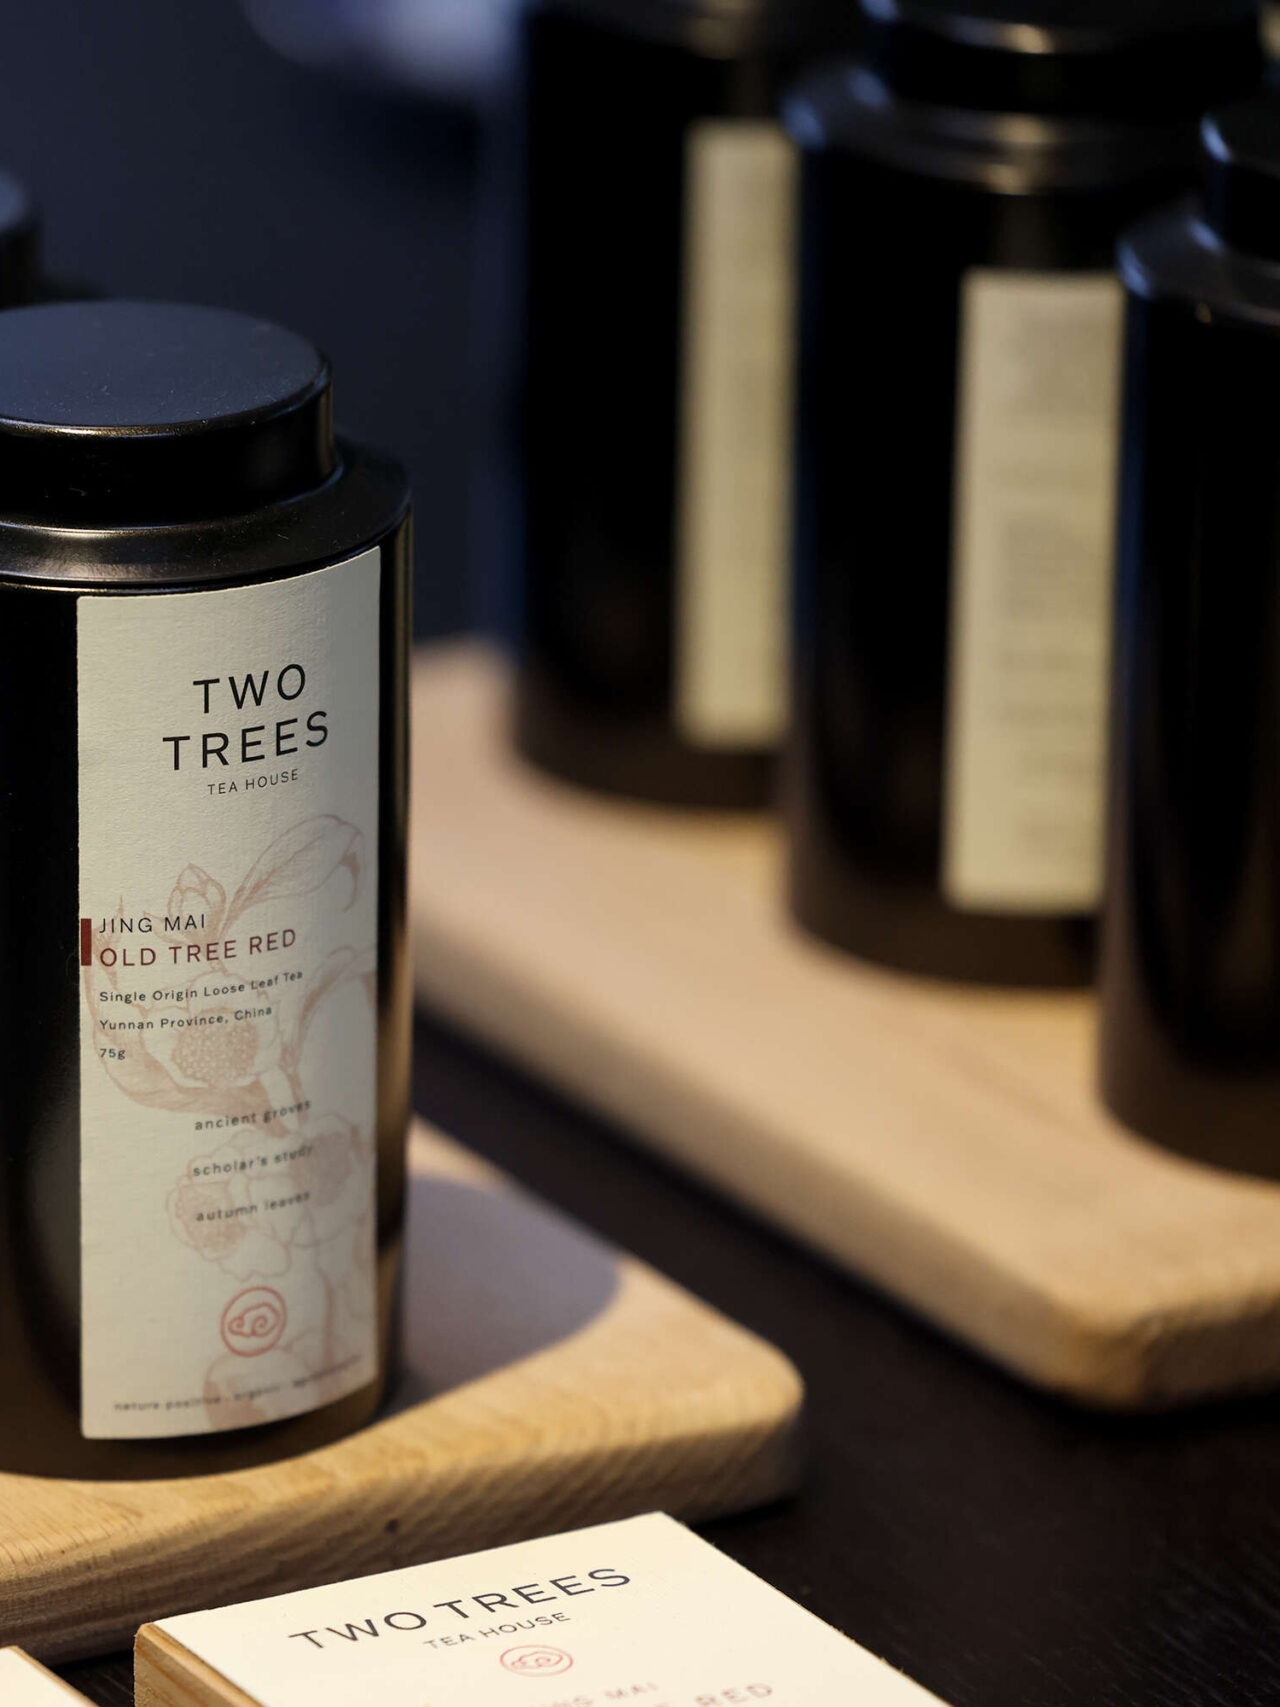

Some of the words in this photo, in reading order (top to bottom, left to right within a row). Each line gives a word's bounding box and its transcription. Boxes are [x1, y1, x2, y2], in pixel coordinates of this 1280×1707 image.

[193, 663, 307, 714] TWO
[162, 710, 329, 770] TREES
[207, 781, 238, 796] TEA
[245, 768, 299, 790] HOUSE
[99, 917, 153, 934] JING
[164, 914, 205, 932] MAI
[99, 948, 157, 967] OLD
[168, 940, 238, 964] TREE
[249, 928, 297, 956] RED
[99, 991, 146, 1004] Single
[152, 988, 198, 1003] Origin
[204, 982, 245, 997] Loose
[251, 975, 279, 991] Leaf
[283, 969, 304, 983] Tea
[99, 1020, 154, 1031] Yunnan
[160, 1014, 229, 1029] Province,
[234, 1006, 272, 1021] China
[99, 1048, 126, 1061] 75g
[195, 1113, 257, 1131] ancient
[262, 1100, 312, 1123] groves
[192, 1155, 268, 1177] scholar's
[273, 1145, 314, 1165] study
[195, 1203, 258, 1222] autumn
[264, 1191, 311, 1211] leaves
[288, 1611, 428, 1649] TWO
[432, 1568, 631, 1620] TREES
[423, 1632, 476, 1649] TEA
[479, 1612, 571, 1639] HOUSE
